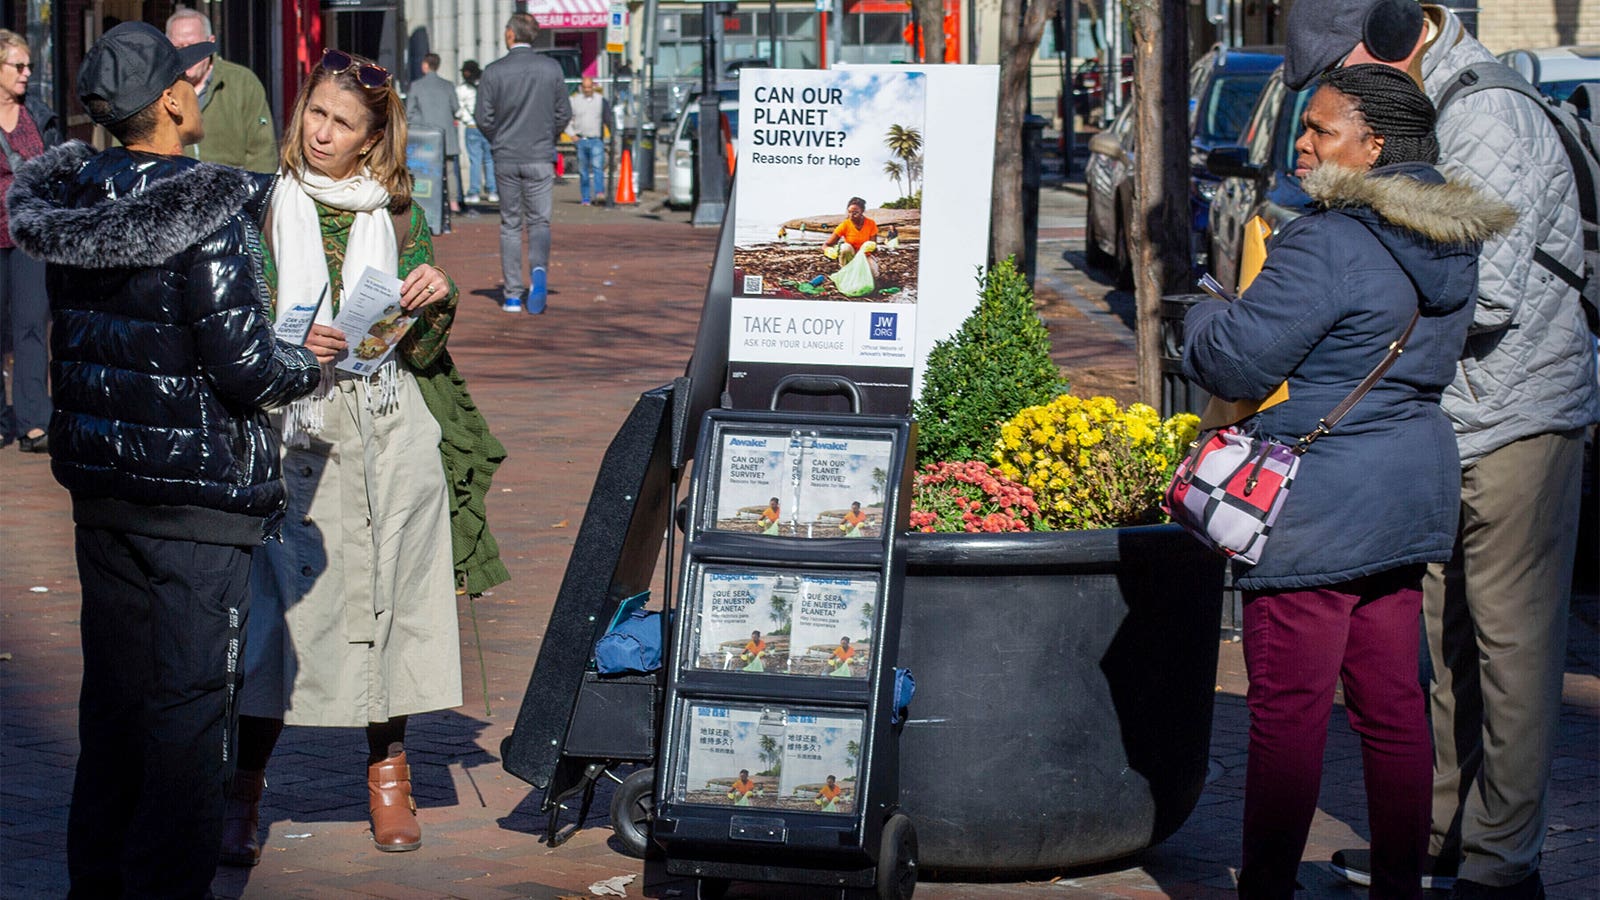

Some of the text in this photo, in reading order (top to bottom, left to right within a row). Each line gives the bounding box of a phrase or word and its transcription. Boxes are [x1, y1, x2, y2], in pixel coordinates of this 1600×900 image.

[536, 14, 562, 25] REAM
[754, 86, 843, 105] CAN OUR
[754, 108, 828, 126] PLANET
[753, 130, 846, 148] SURVIVE?
[752, 152, 860, 168] Reasons for Hope
[744, 316, 844, 335] TAKE A COPY
[874, 316, 893, 327] JW
[744, 338, 844, 350] ASK FOR YOUR LANGUAGE
[729, 438, 767, 447] Awake!
[812, 440, 848, 450] Awake!
[811, 474, 846, 482] SURVIVE?
[814, 601, 847, 610] NUESTRO
[801, 608, 836, 616] PLANETA?
